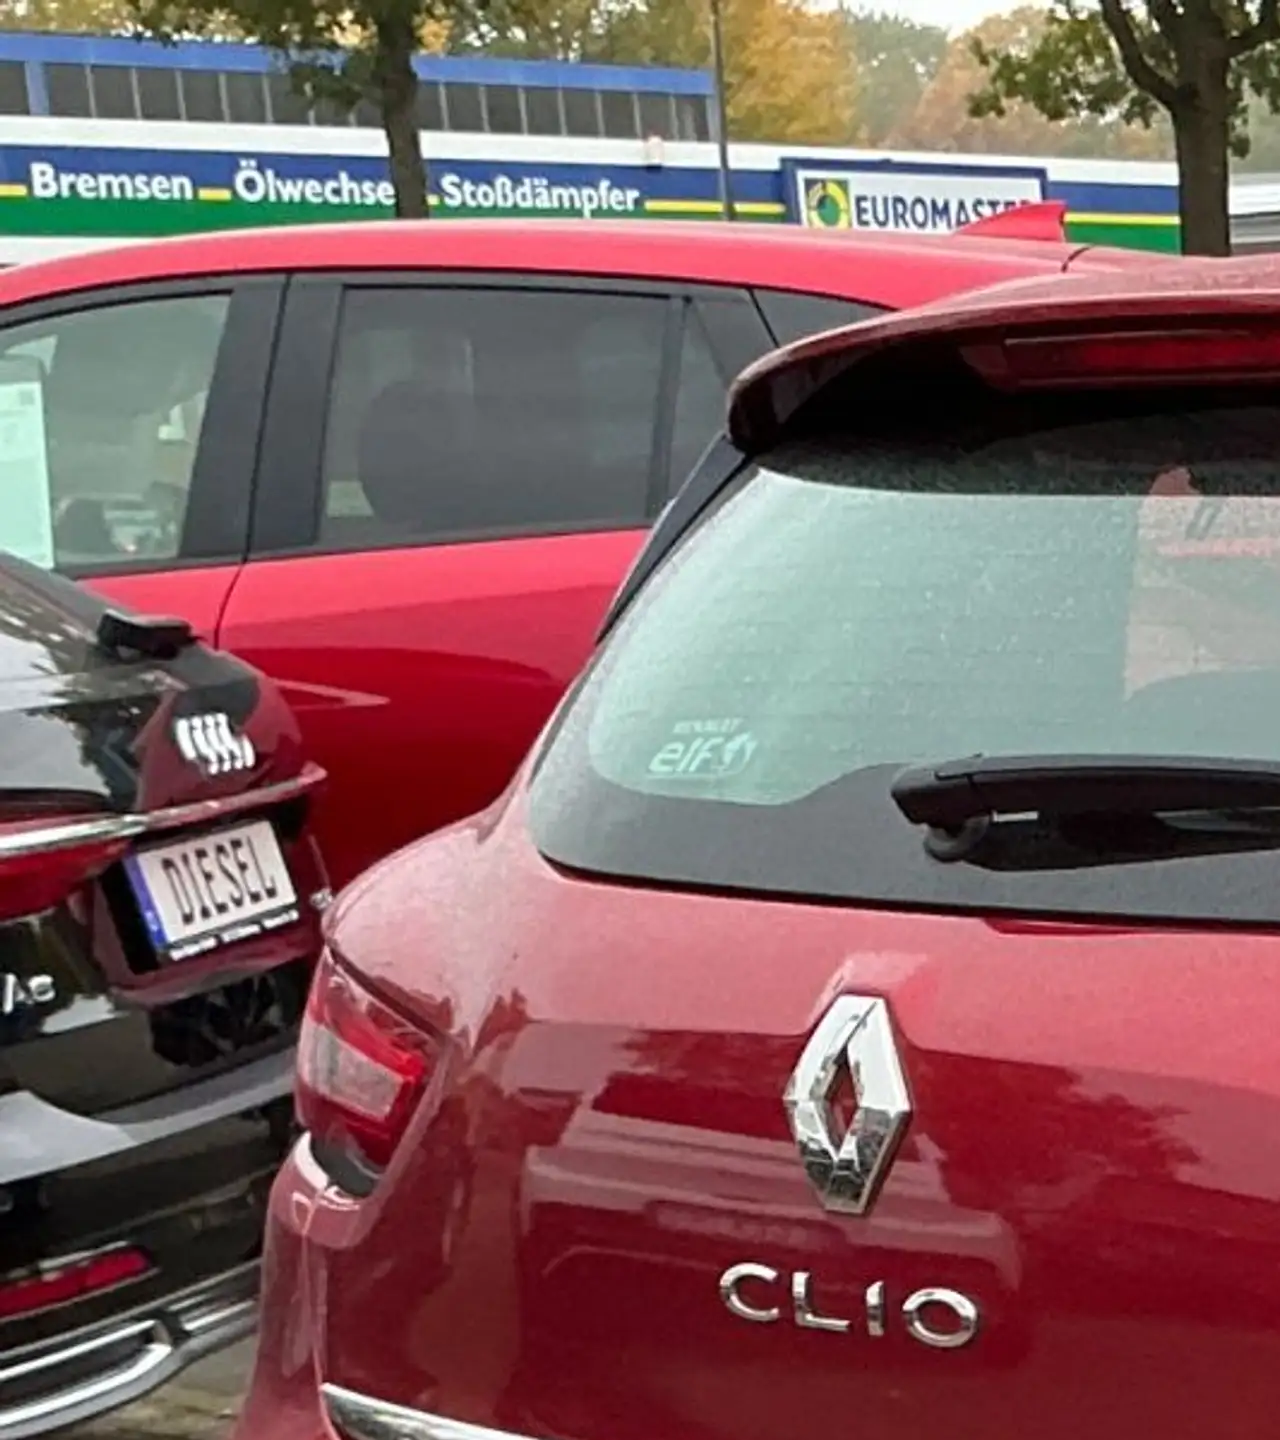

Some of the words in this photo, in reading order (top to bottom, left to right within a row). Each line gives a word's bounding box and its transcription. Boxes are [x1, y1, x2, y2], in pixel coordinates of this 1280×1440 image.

[29, 161, 194, 201] Bremsen
[234, 159, 398, 207] Ölwechse
[439, 173, 641, 219] Stoßdämpfer
[161, 835, 280, 925] DIESEL
[718, 1261, 980, 1349] CLIO
